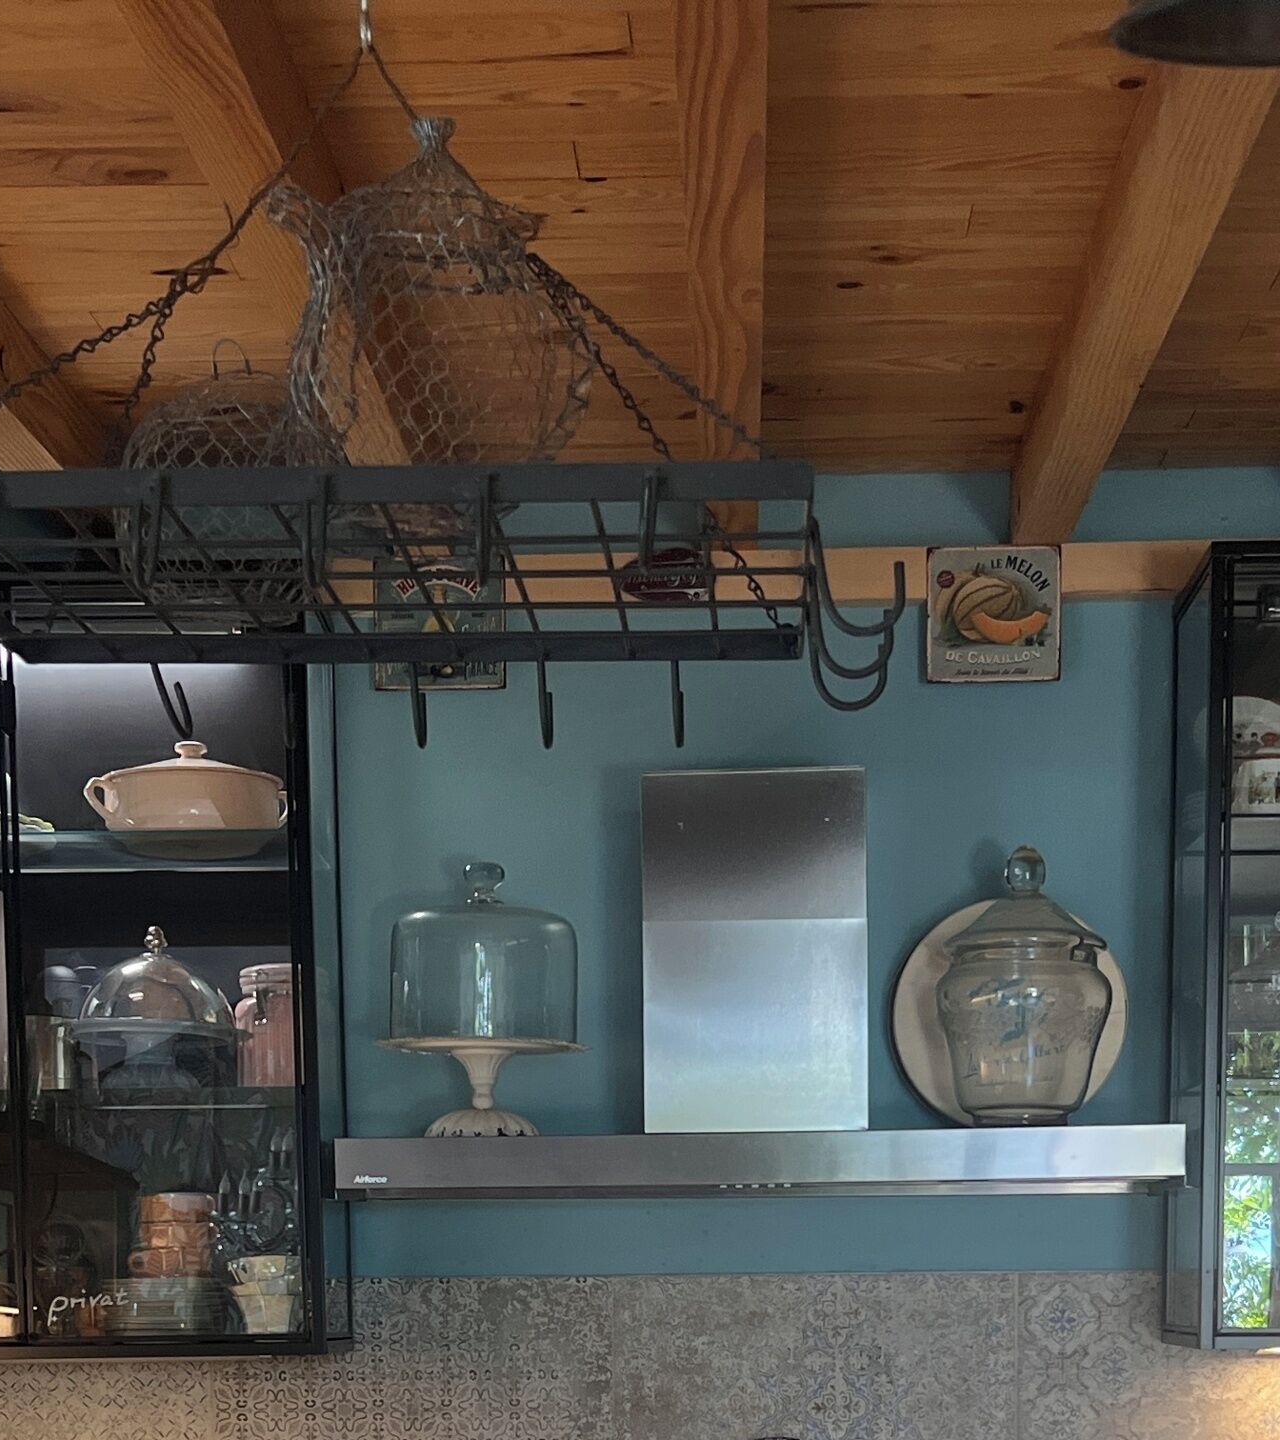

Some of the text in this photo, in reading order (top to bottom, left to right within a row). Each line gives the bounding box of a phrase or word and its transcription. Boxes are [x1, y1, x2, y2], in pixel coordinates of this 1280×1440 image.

[991, 555, 1050, 592] LE MELON
[945, 650, 1041, 664] DE CAVAILLON
[46, 1286, 131, 1327] privat
